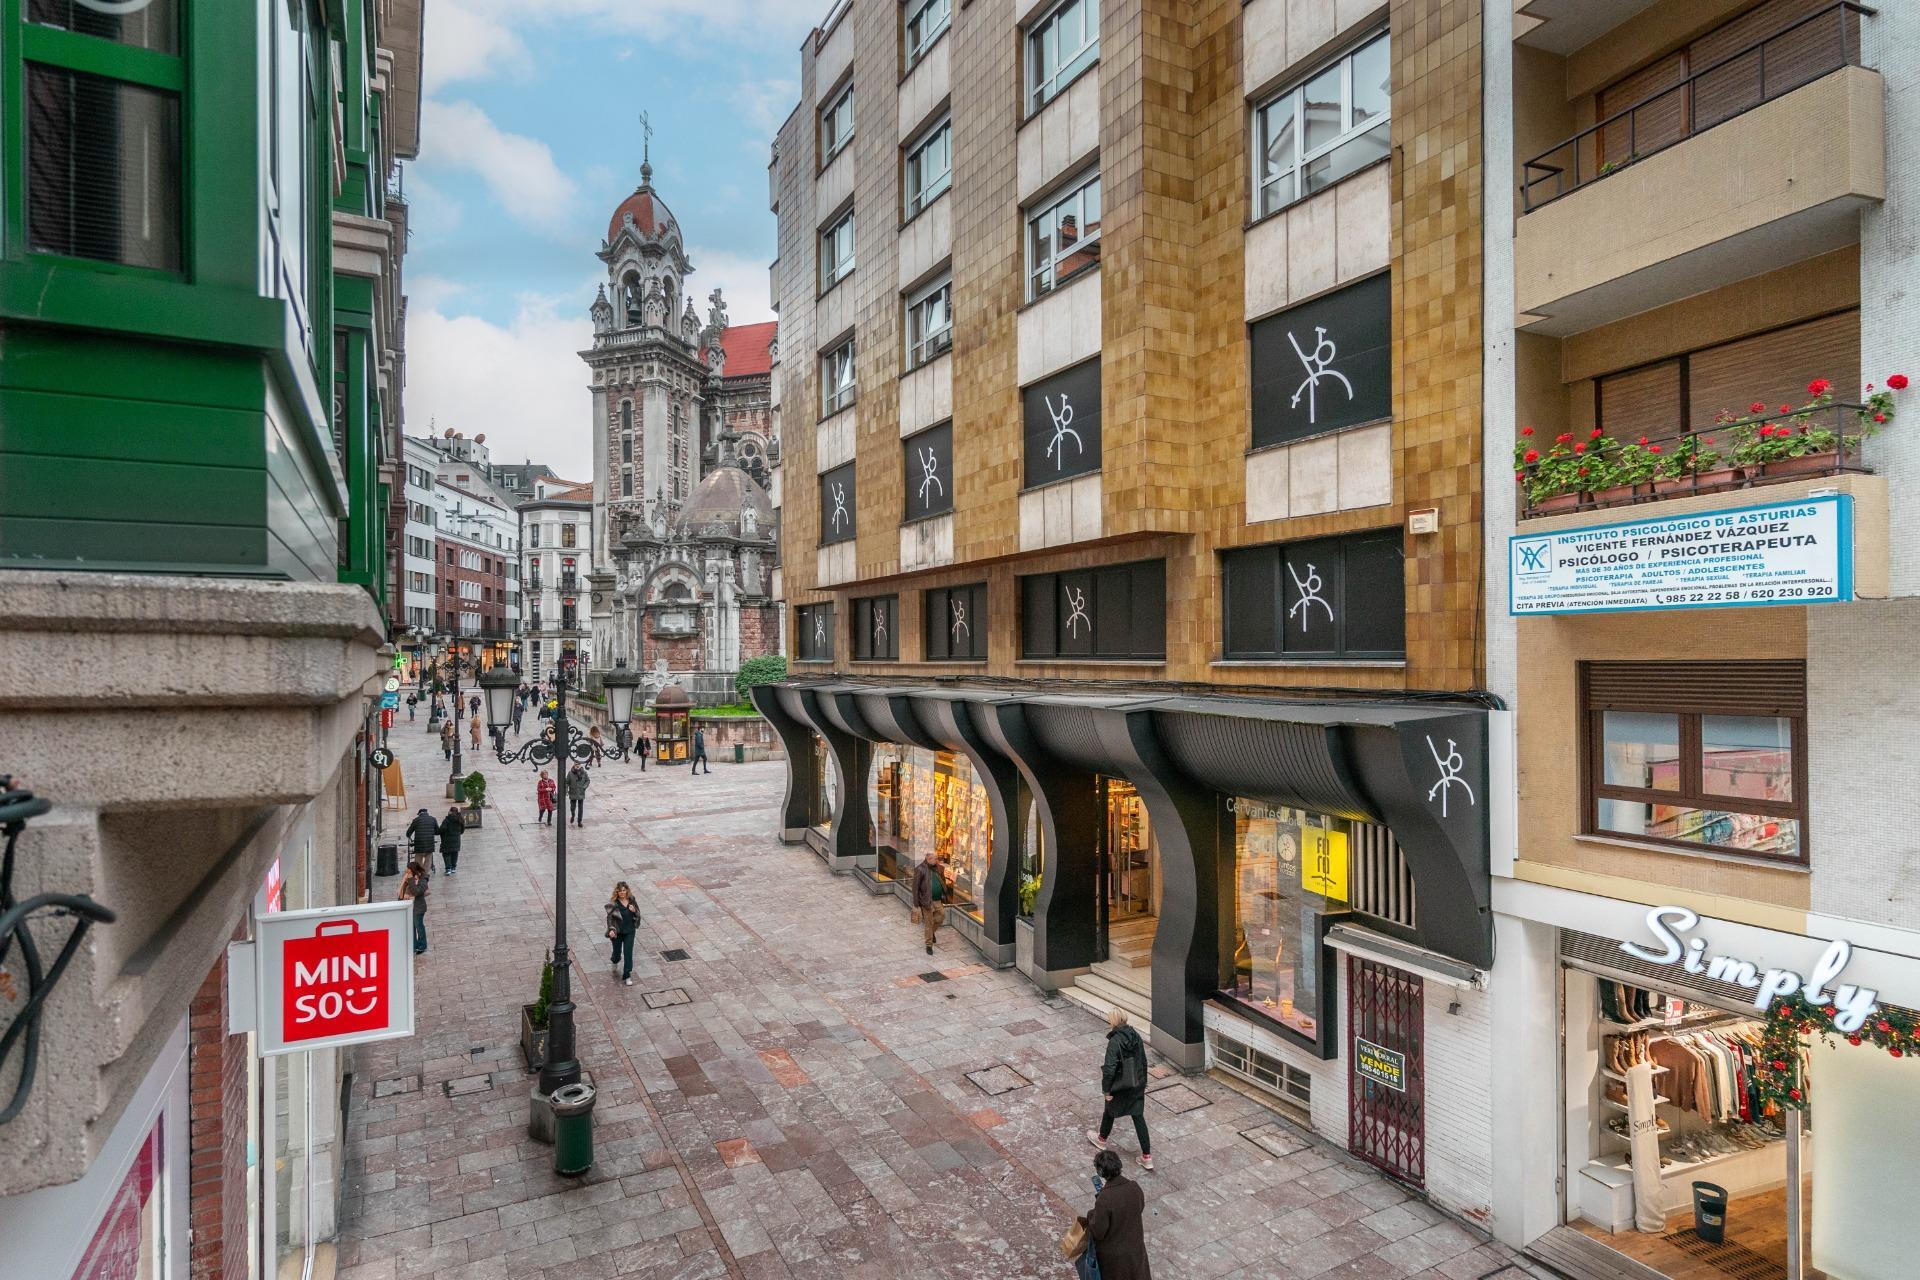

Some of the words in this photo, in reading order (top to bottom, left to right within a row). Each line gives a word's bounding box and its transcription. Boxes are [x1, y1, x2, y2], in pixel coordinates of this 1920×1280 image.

[1558, 530, 1618, 545] INSTITUTO
[1622, 520, 1710, 537] PSICOLÓGICO
[1715, 516, 1734, 527] DE
[1738, 506, 1817, 524] ASTURIAS
[1576, 540, 1627, 553] VICENTE
[1632, 530, 1712, 548] FERNÁNDEZ
[1716, 522, 1789, 539] VÁZQUEZ
[1559, 551, 1639, 568] PSICÓLOGO
[1661, 535, 1818, 559] PSICOTERAPEUTA
[1648, 558, 1701, 569] EXPERIENCIA
[1703, 553, 1764, 564] PROFESIONAL
[1576, 573, 1633, 582] PSICOTERAPIA
[1641, 569, 1680, 578] ADULTOS
[1688, 563, 1765, 575] ADOLESCENTES
[1516, 602, 1534, 610] CITA
[1535, 600, 1565, 609] PREVIA
[1605, 597, 1648, 606] INMEDIATA)
[1666, 594, 1686, 603] 985
[1690, 593, 1704, 602] 22
[1707, 592, 1722, 601] 22
[1725, 590, 1740, 600] 58
[1751, 589, 1774, 599] 620
[1778, 588, 1803, 597] 230
[1807, 586, 1833, 596] 920
[294, 952, 378, 988] MINI
[1619, 905, 1880, 1033] Simply
[1359, 1053, 1400, 1077] VENDE
